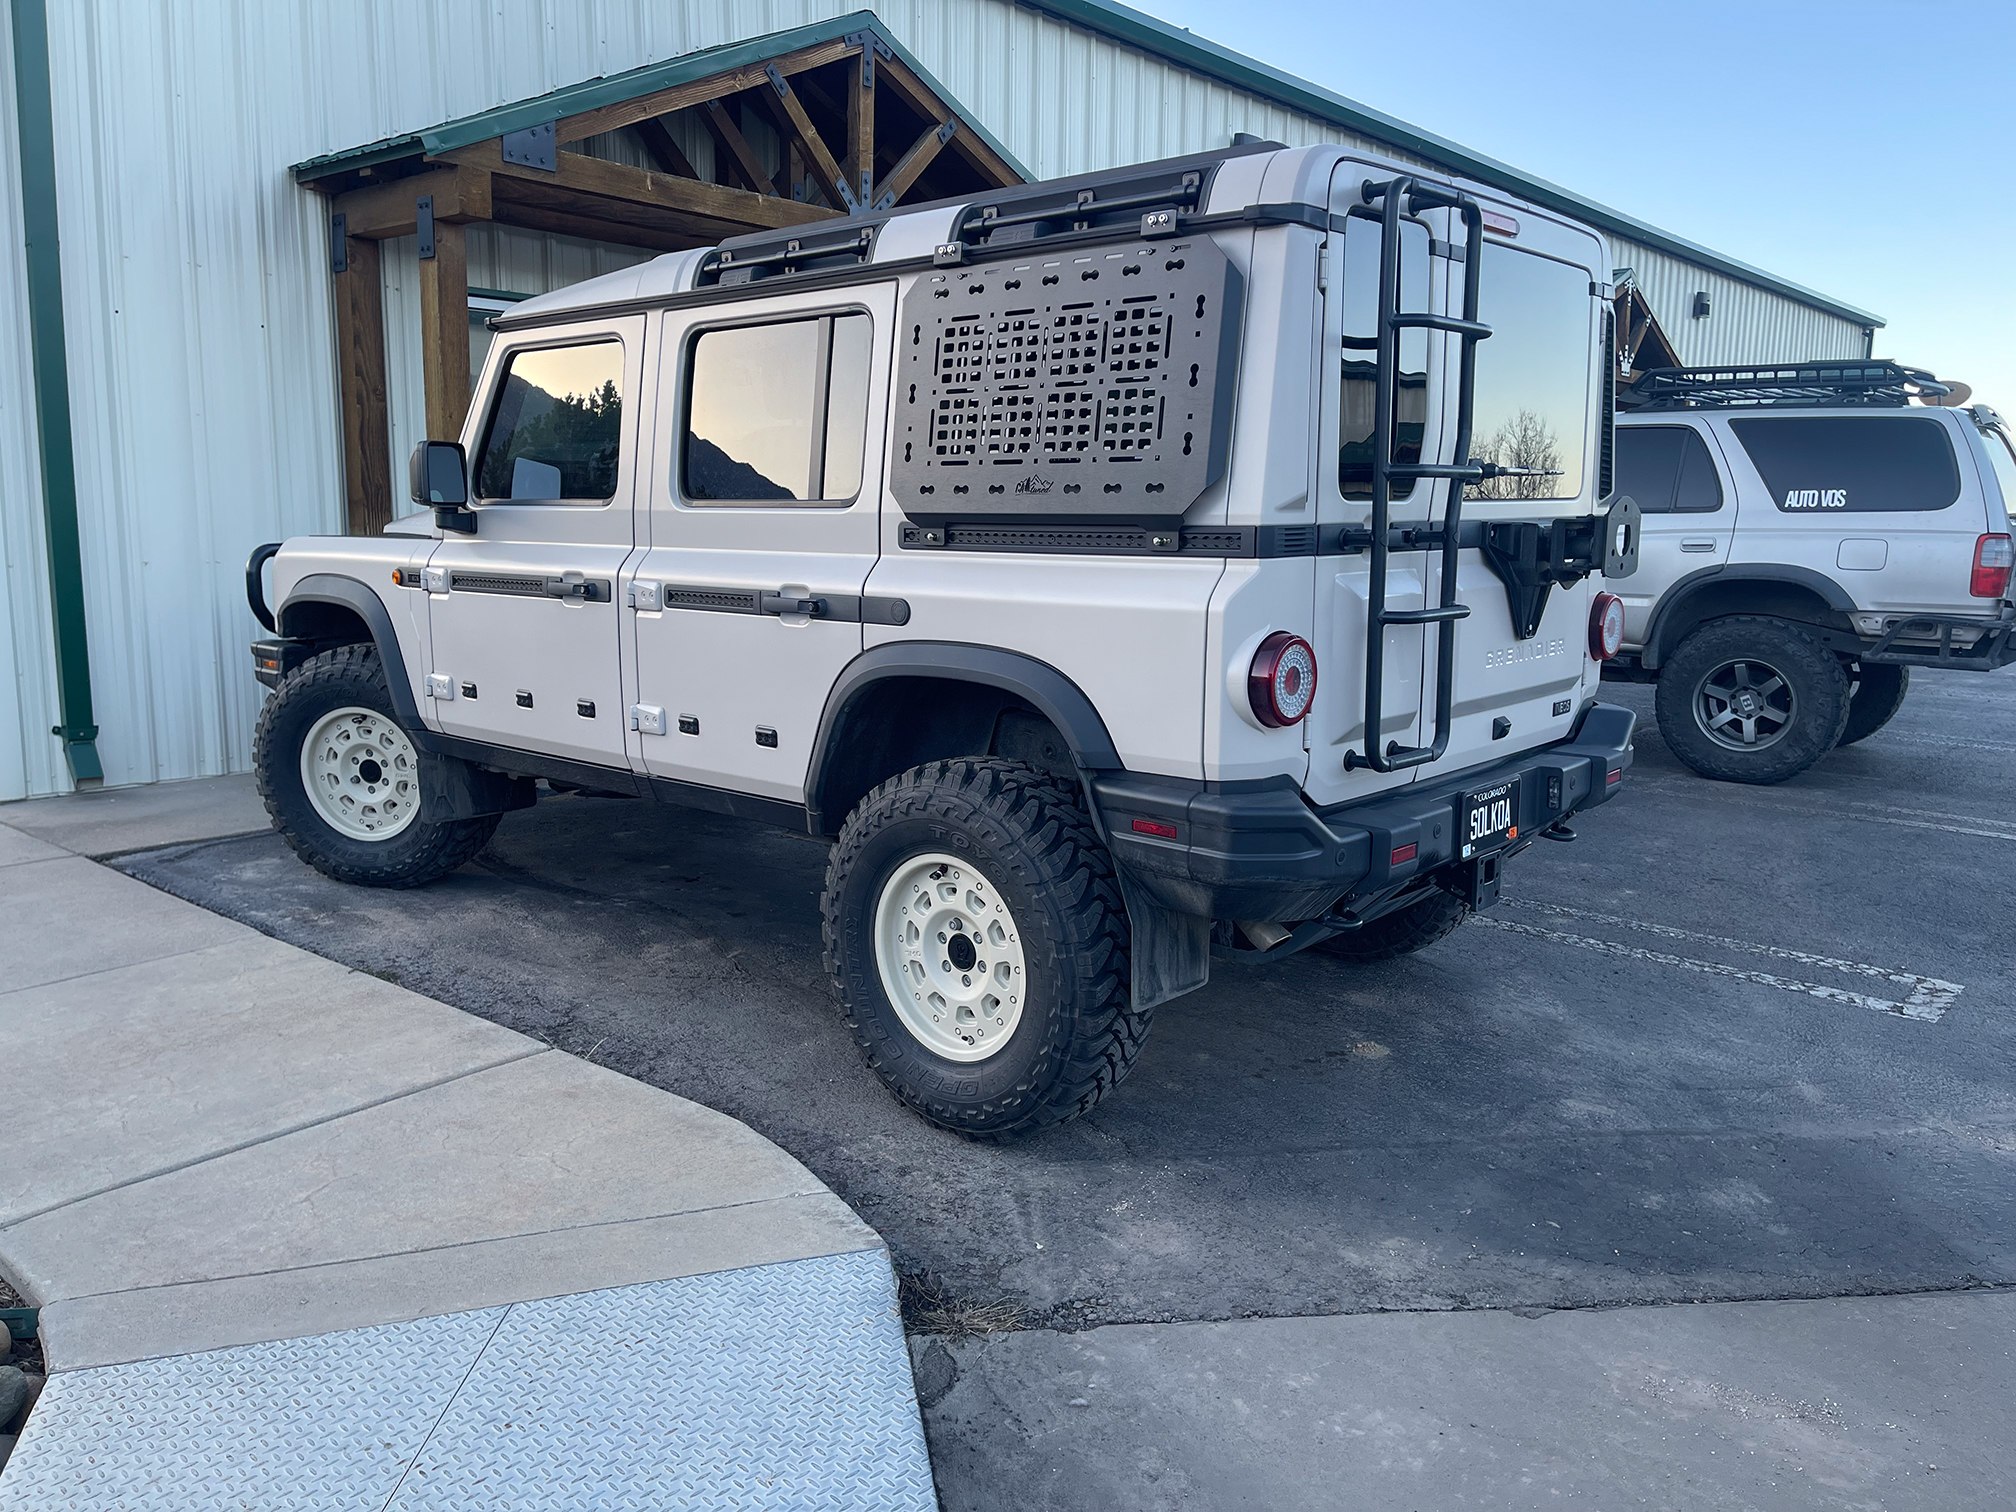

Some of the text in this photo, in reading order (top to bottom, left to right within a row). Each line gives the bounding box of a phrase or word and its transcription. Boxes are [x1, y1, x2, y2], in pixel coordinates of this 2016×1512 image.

[1784, 489, 1847, 508] AUTO VOS
[1485, 638, 1565, 669] GRENADIER
[1554, 700, 1570, 716] INEOS
[1477, 785, 1507, 802] COLORADO
[1470, 797, 1511, 841] SOLKOA
[929, 824, 1008, 884] TOYO
[845, 916, 979, 1096] OPEN COUNTRY
